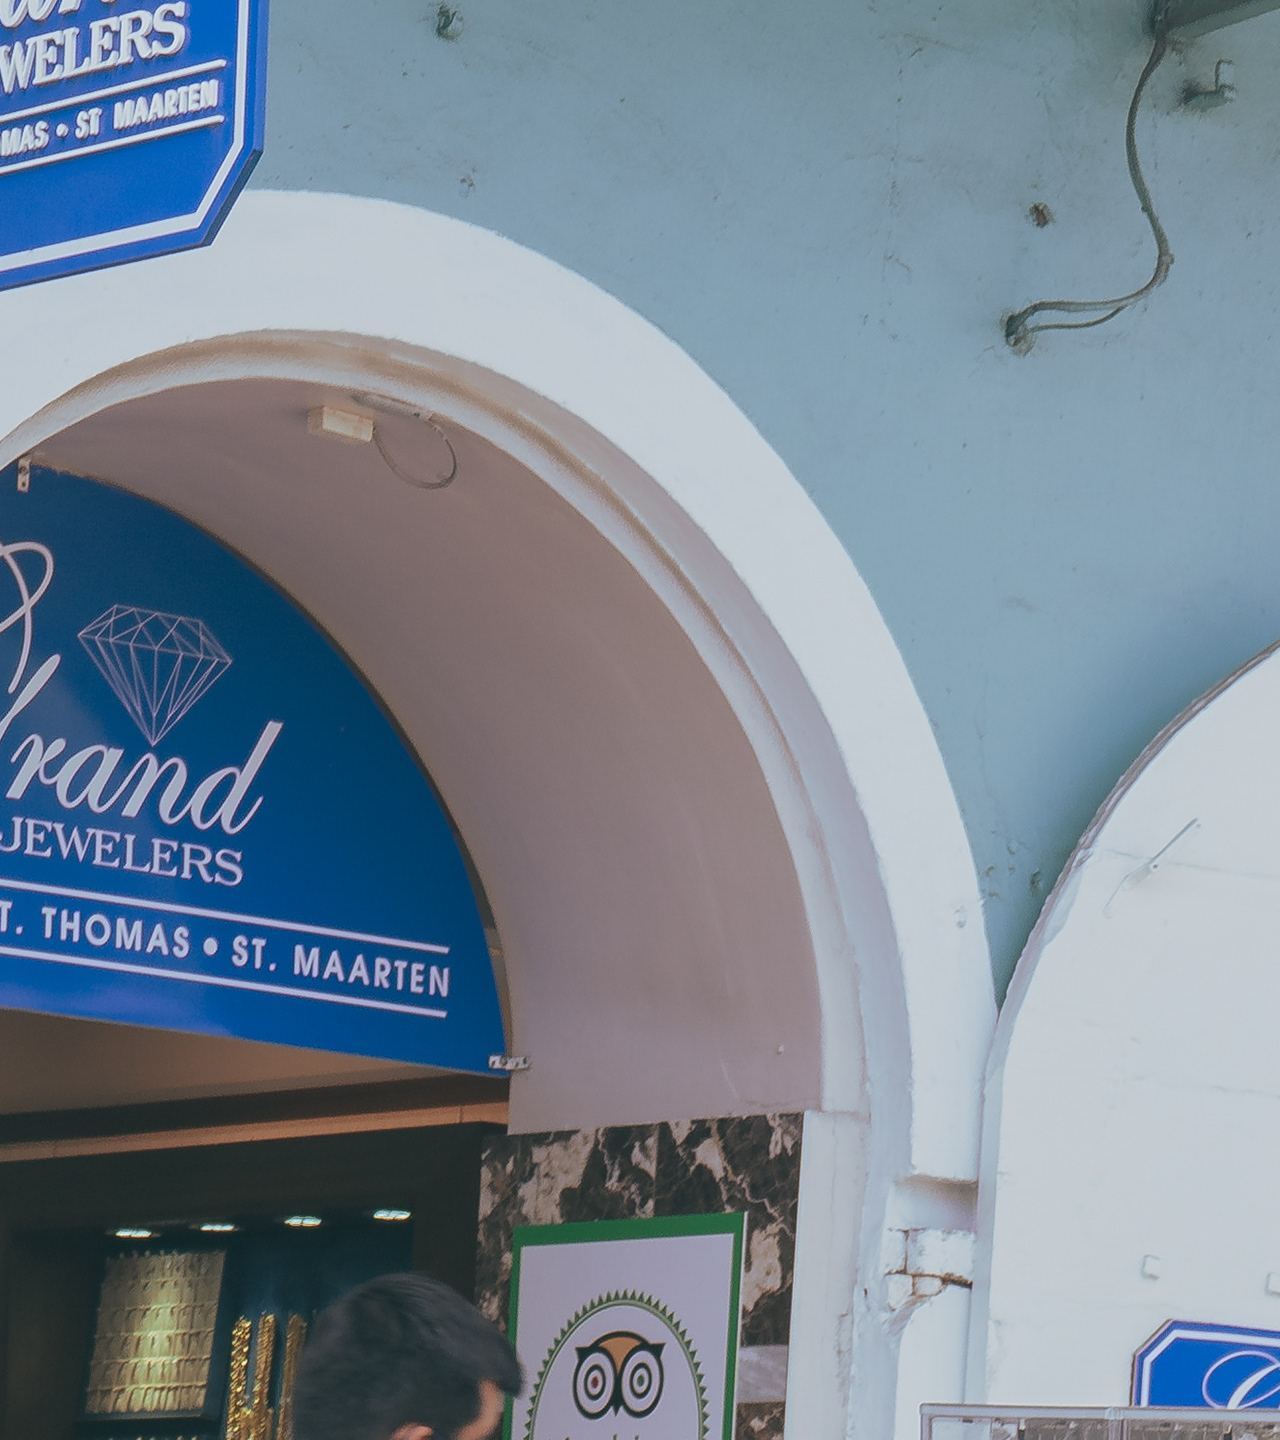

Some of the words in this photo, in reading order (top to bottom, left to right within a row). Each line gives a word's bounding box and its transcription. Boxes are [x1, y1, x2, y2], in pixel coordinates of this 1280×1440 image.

[74, 107, 102, 139] ST
[113, 78, 219, 131] MAARTEN
[41, 906, 191, 959] THOMAS
[230, 935, 277, 972] ST.
[293, 944, 451, 997] MAARTEN
